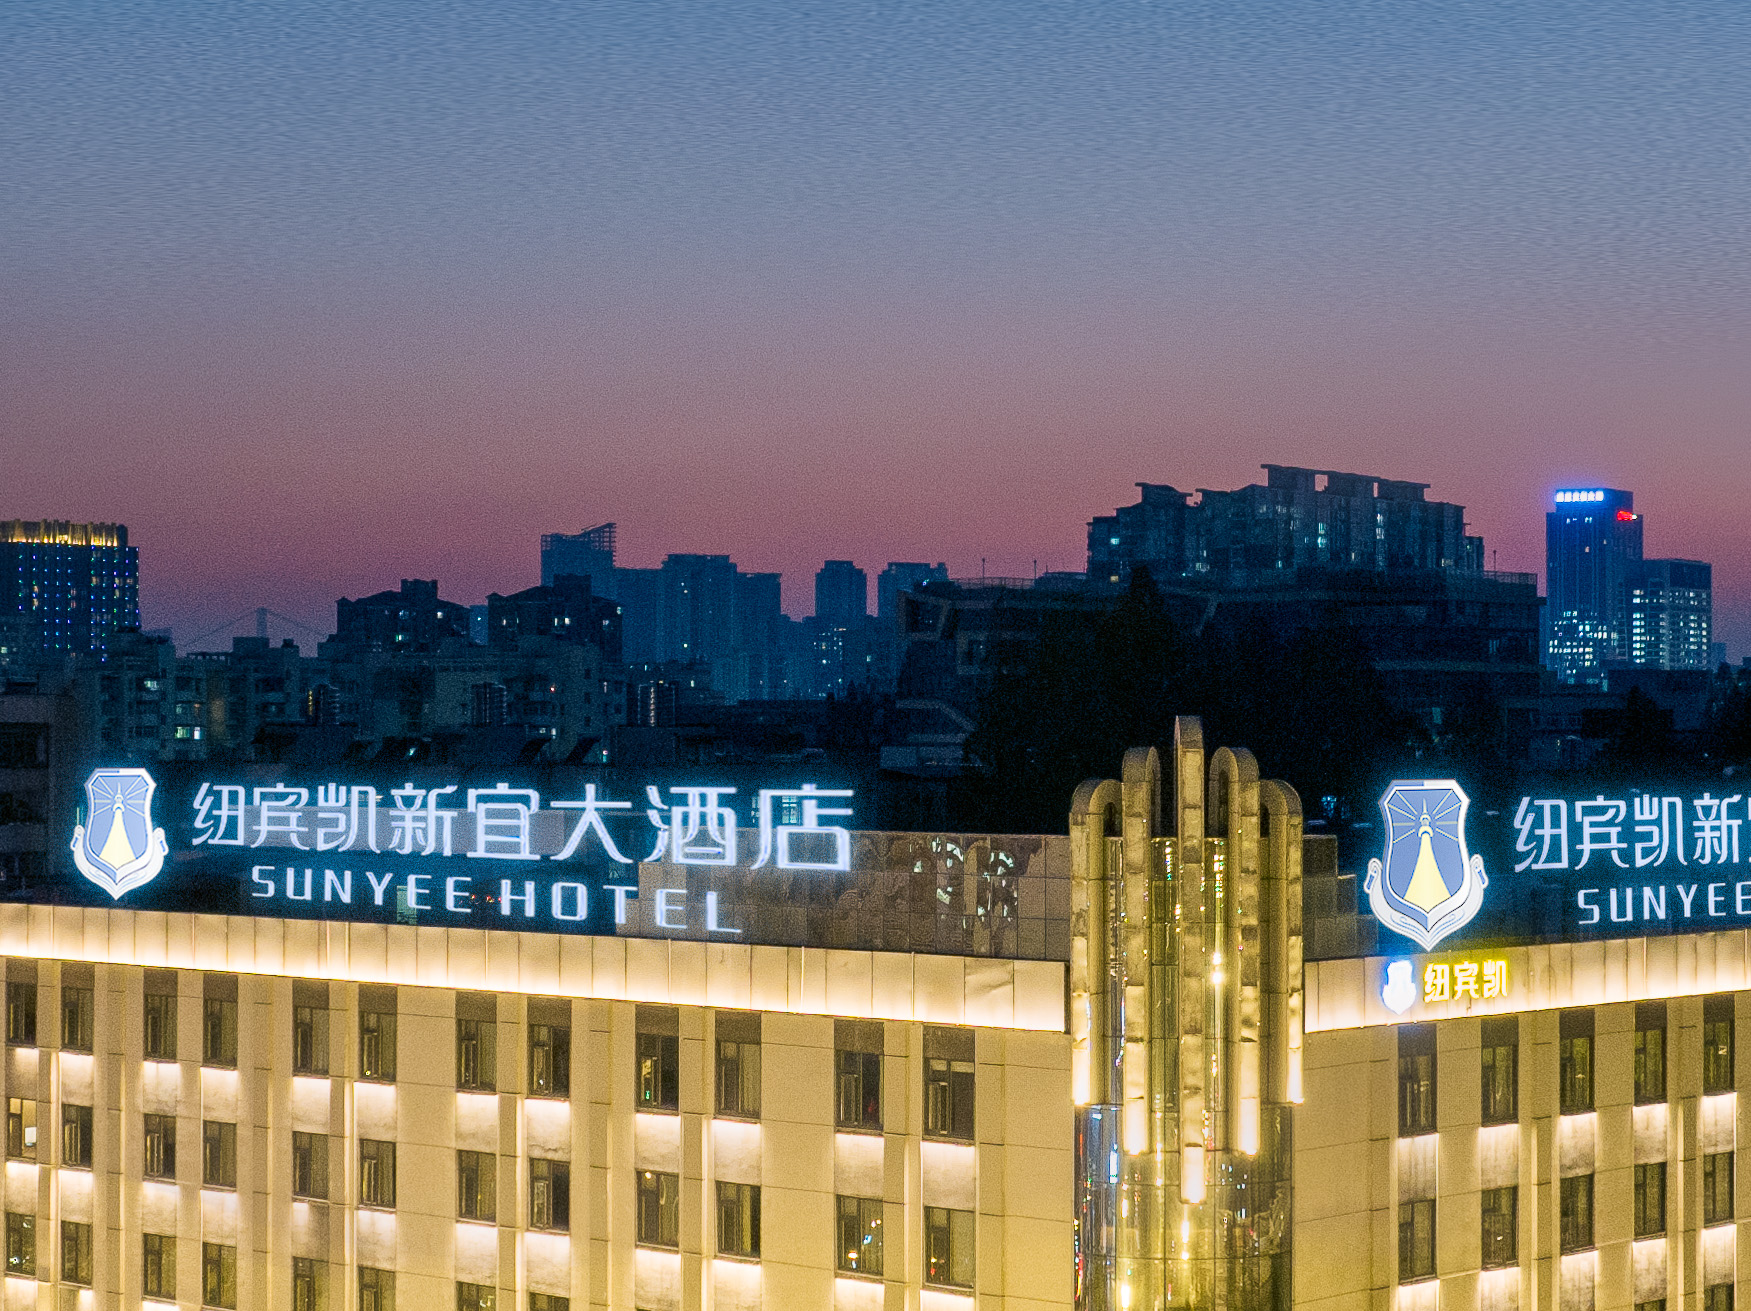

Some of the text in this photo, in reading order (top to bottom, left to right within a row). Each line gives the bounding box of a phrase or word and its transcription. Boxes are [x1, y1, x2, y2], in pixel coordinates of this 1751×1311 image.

[191, 780, 856, 872] 纽宾凯新宜大酒店
[251, 864, 744, 935] SUNYEE HOTEL
[1422, 957, 1509, 1003] 纽宾凯
